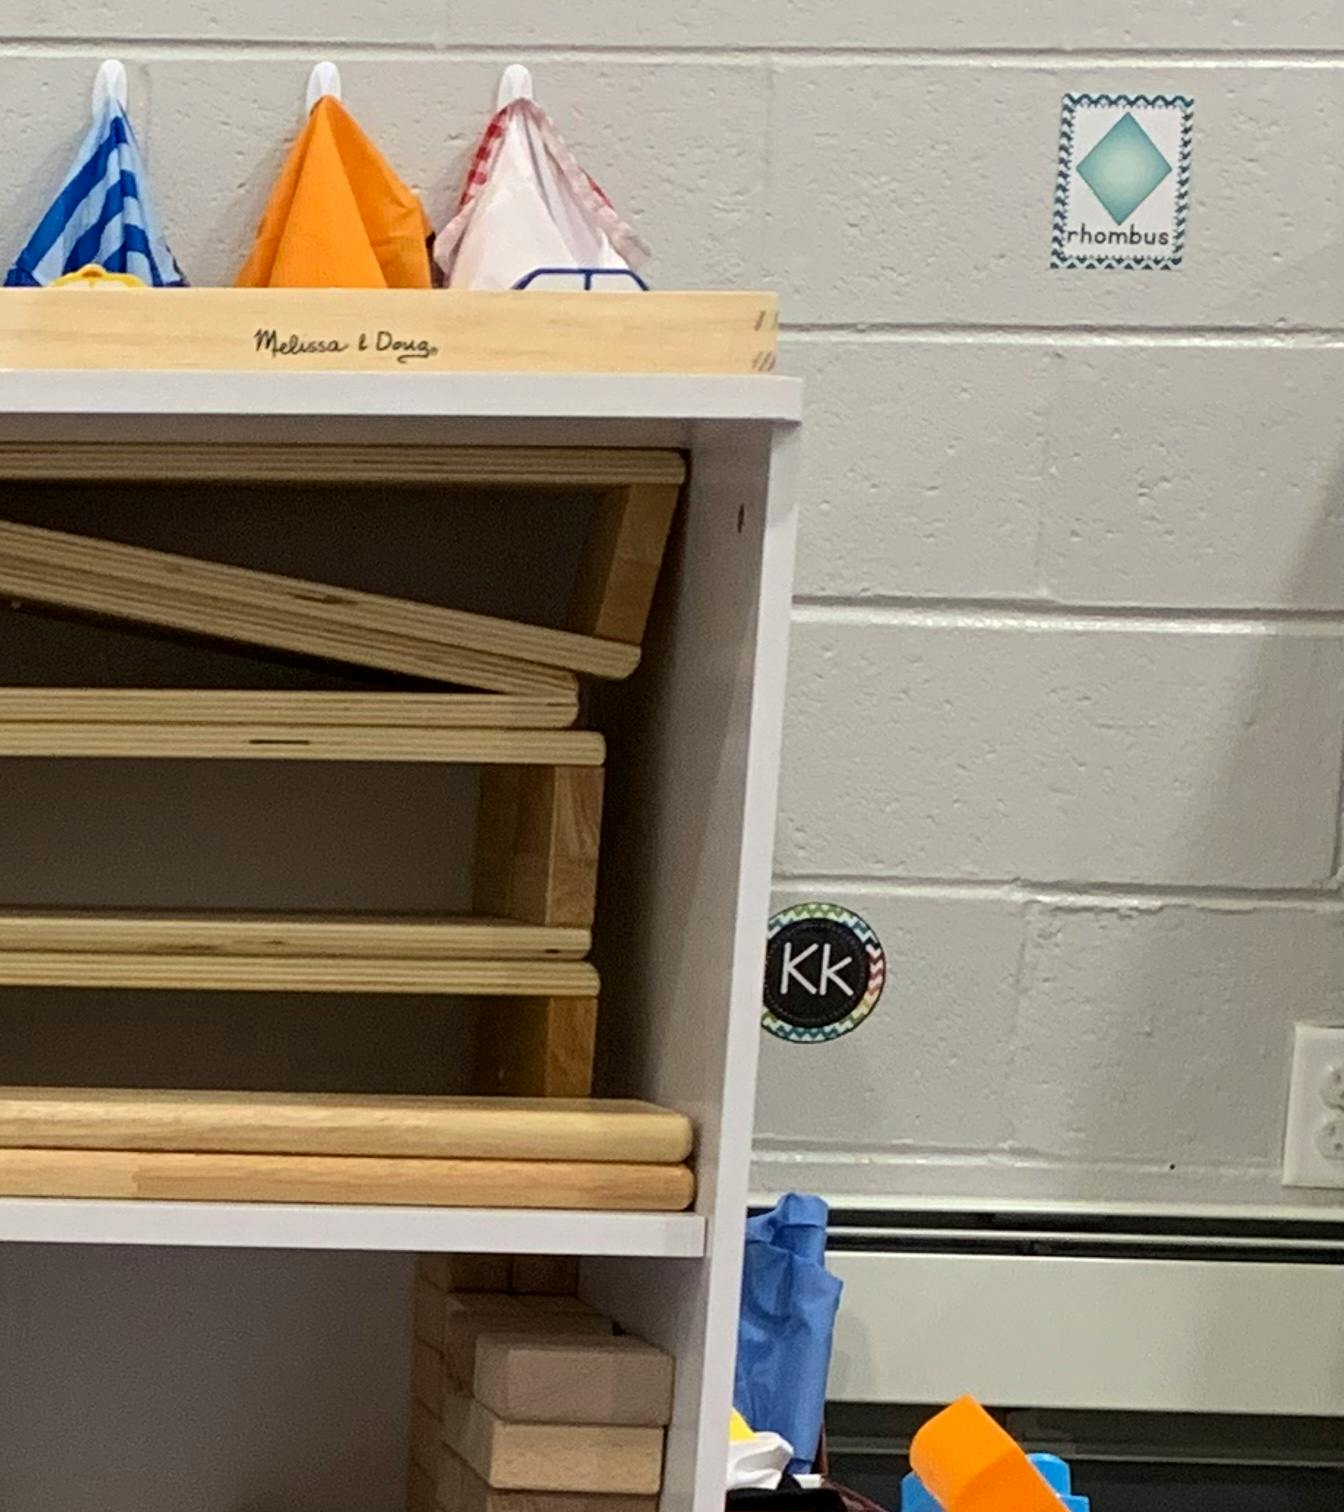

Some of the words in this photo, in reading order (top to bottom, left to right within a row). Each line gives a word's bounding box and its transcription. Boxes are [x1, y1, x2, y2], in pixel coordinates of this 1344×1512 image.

[1066, 223, 1170, 246] rhombus
[254, 327, 350, 358] Melissa
[780, 941, 855, 996] Kk
